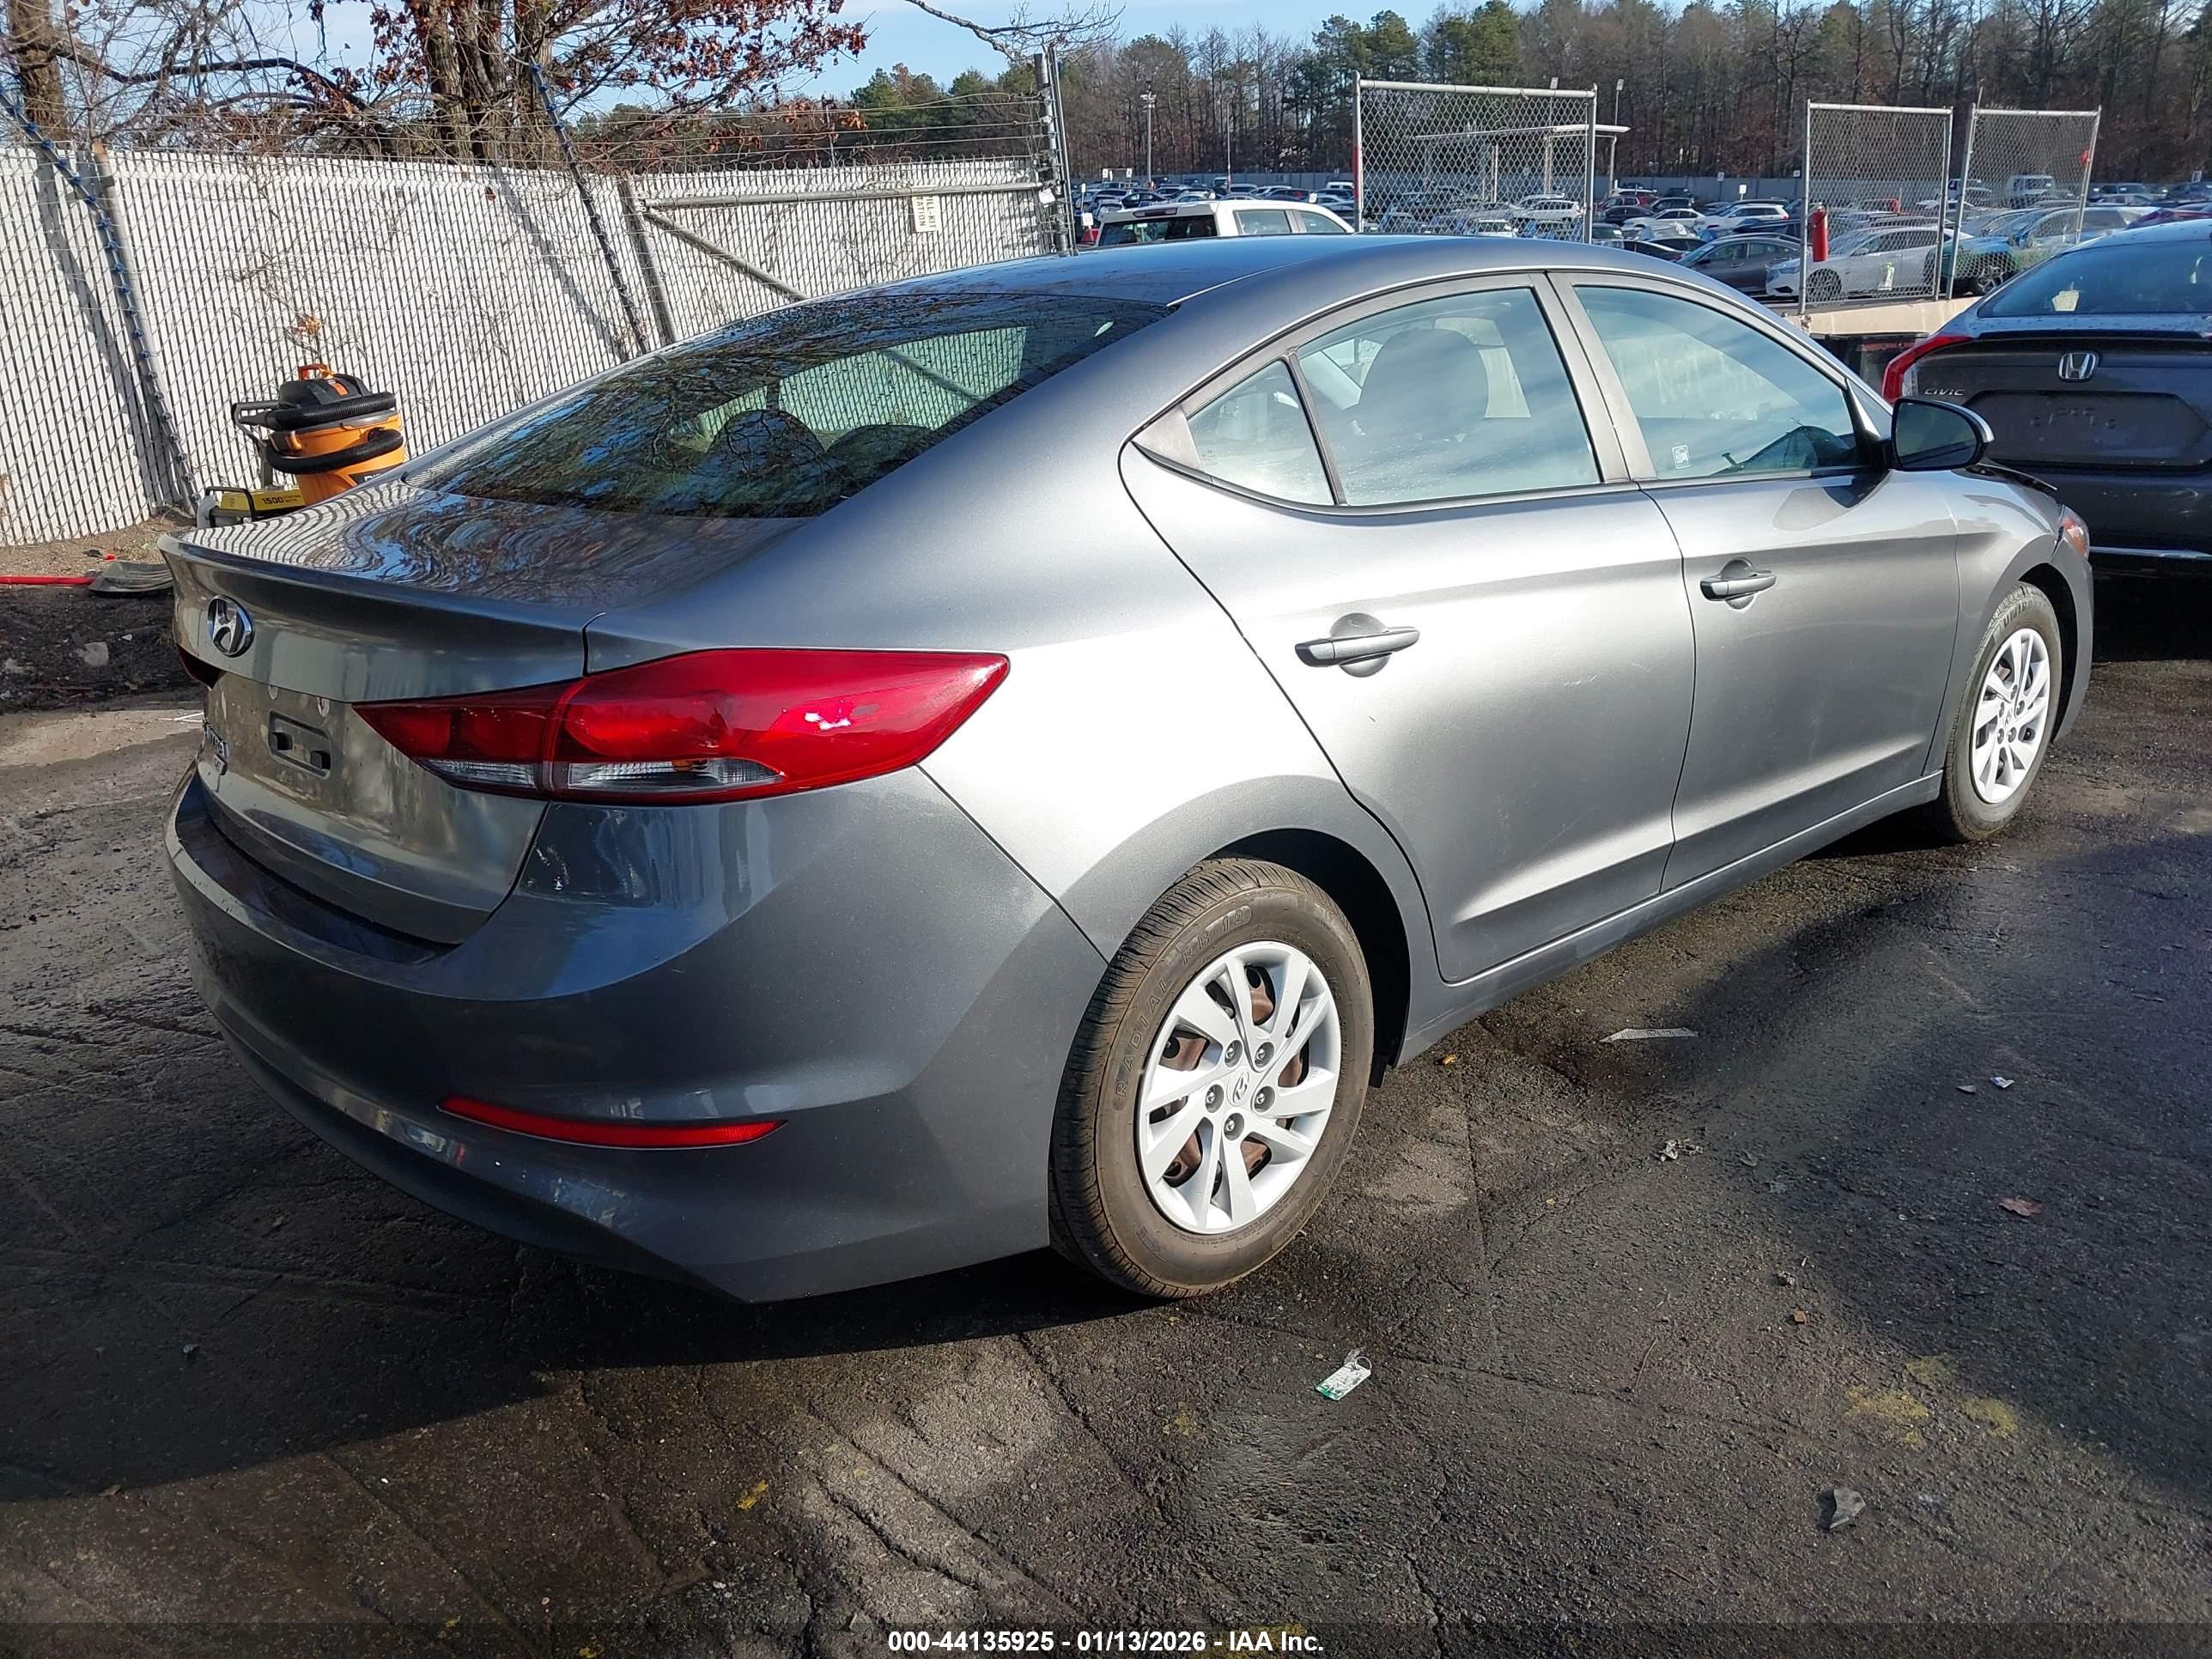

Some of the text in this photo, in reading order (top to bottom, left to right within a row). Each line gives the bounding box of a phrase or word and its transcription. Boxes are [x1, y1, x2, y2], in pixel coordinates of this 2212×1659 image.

[916, 195, 927, 227] TATION
[262, 496, 284, 505] 1500
[1115, 978, 1173, 1097] RADIAL
